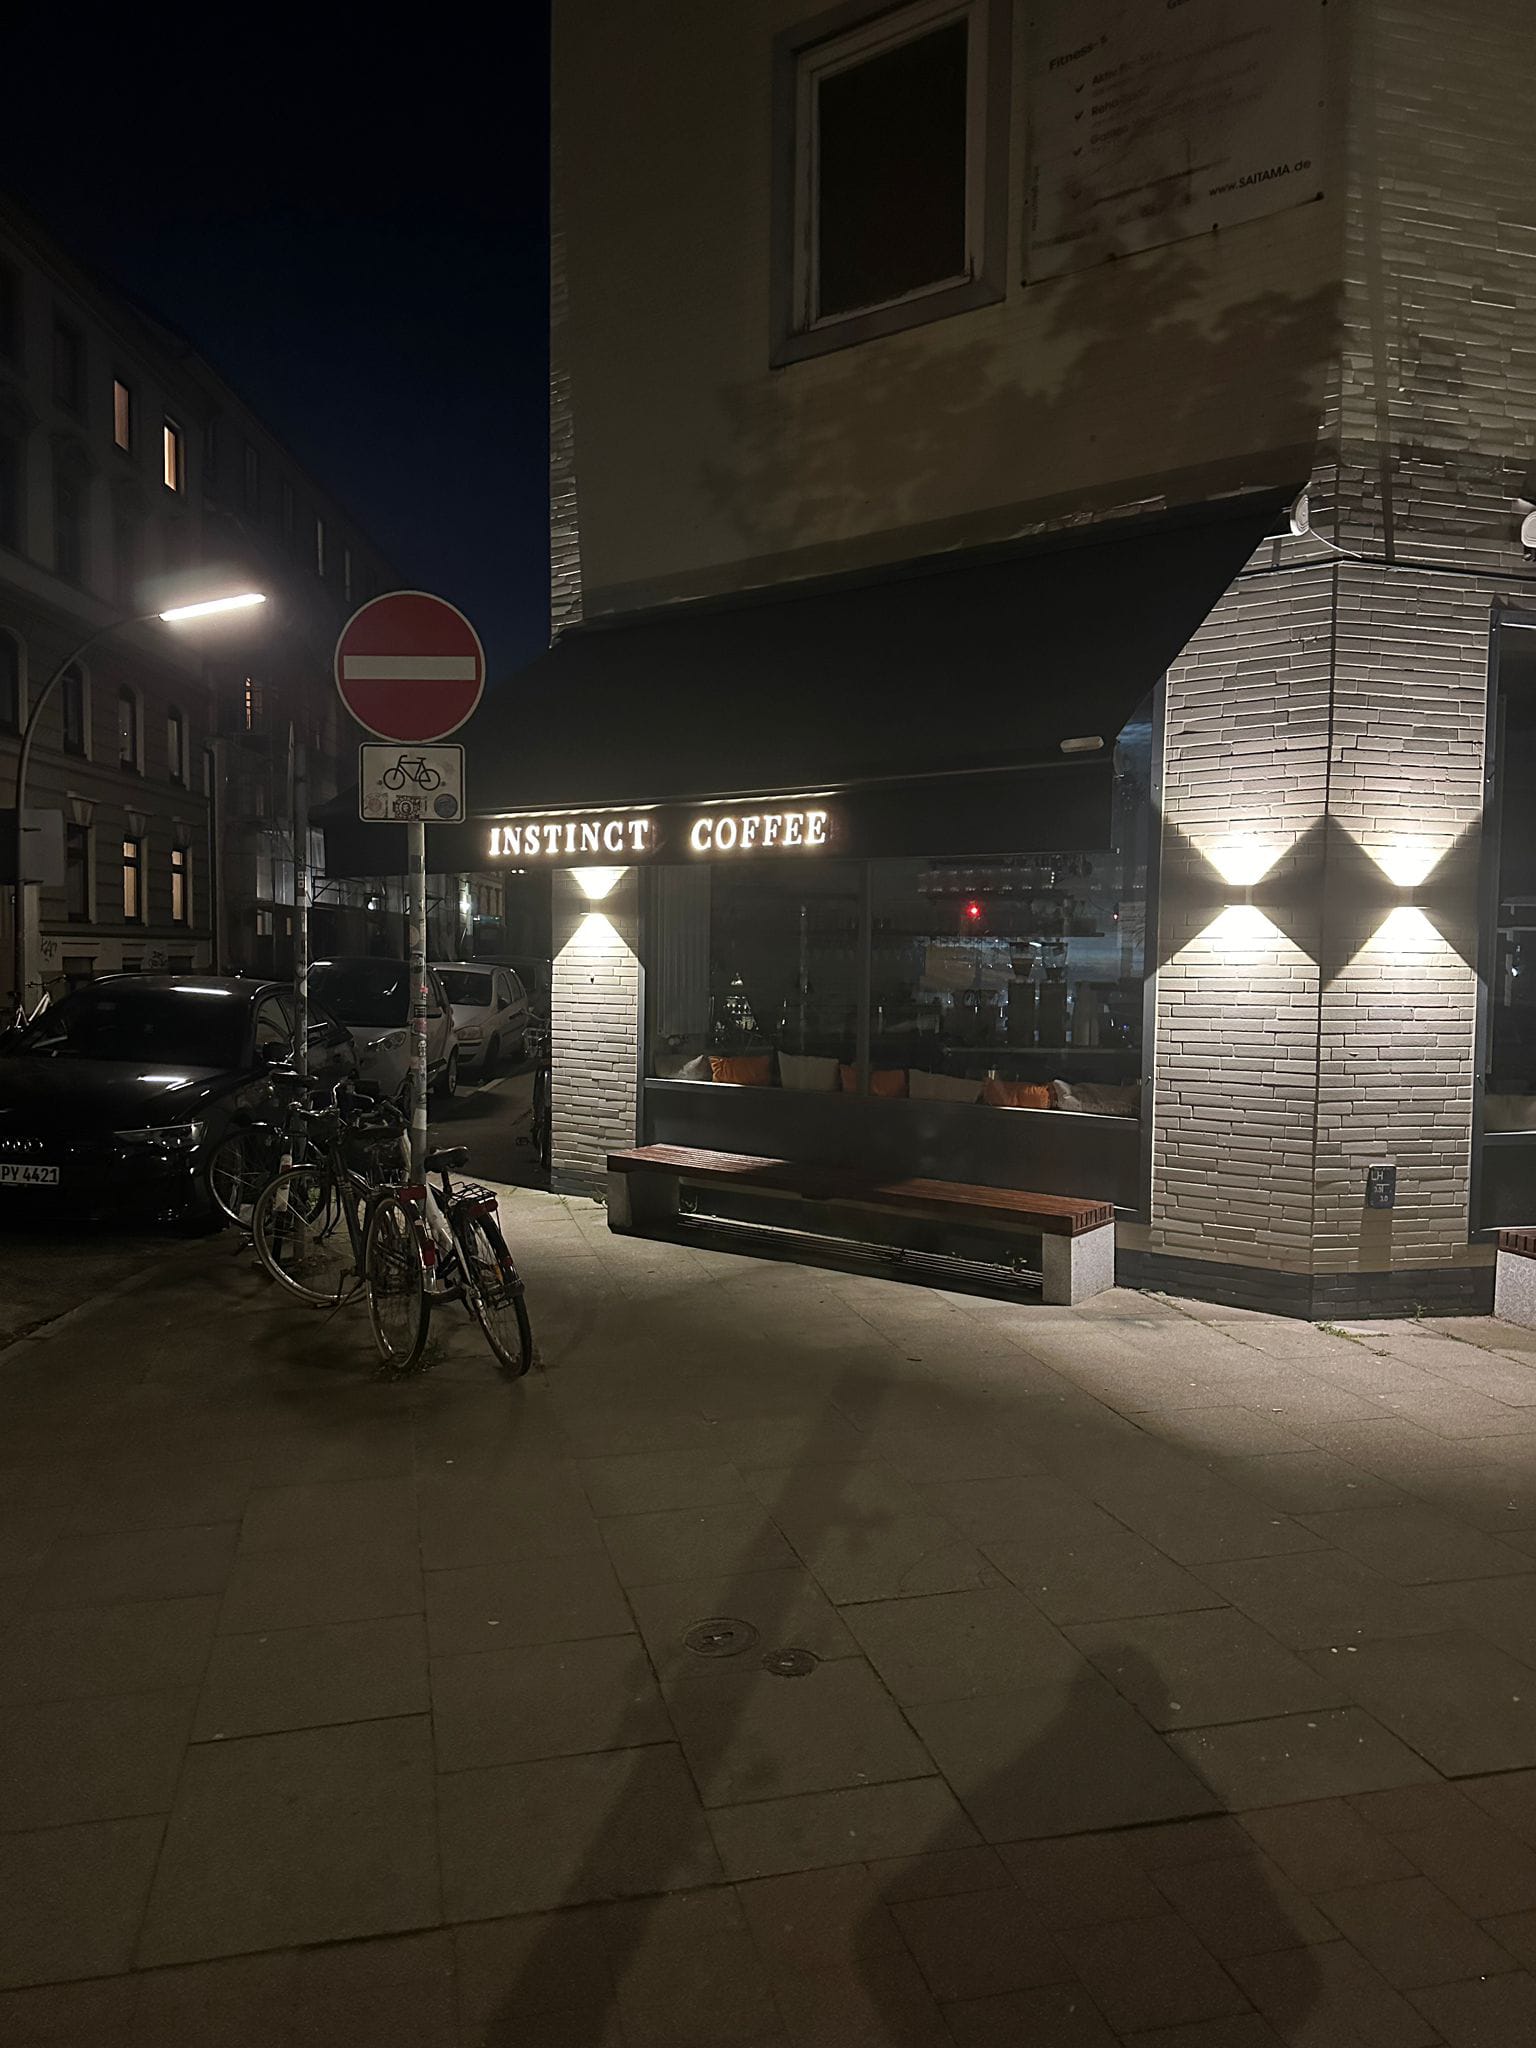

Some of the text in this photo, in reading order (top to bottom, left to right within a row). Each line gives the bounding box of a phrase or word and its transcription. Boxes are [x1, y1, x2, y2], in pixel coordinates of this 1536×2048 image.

[488, 810, 828, 856] INSTINCT COFFEE
[22, 1167, 58, 1183] 4421
